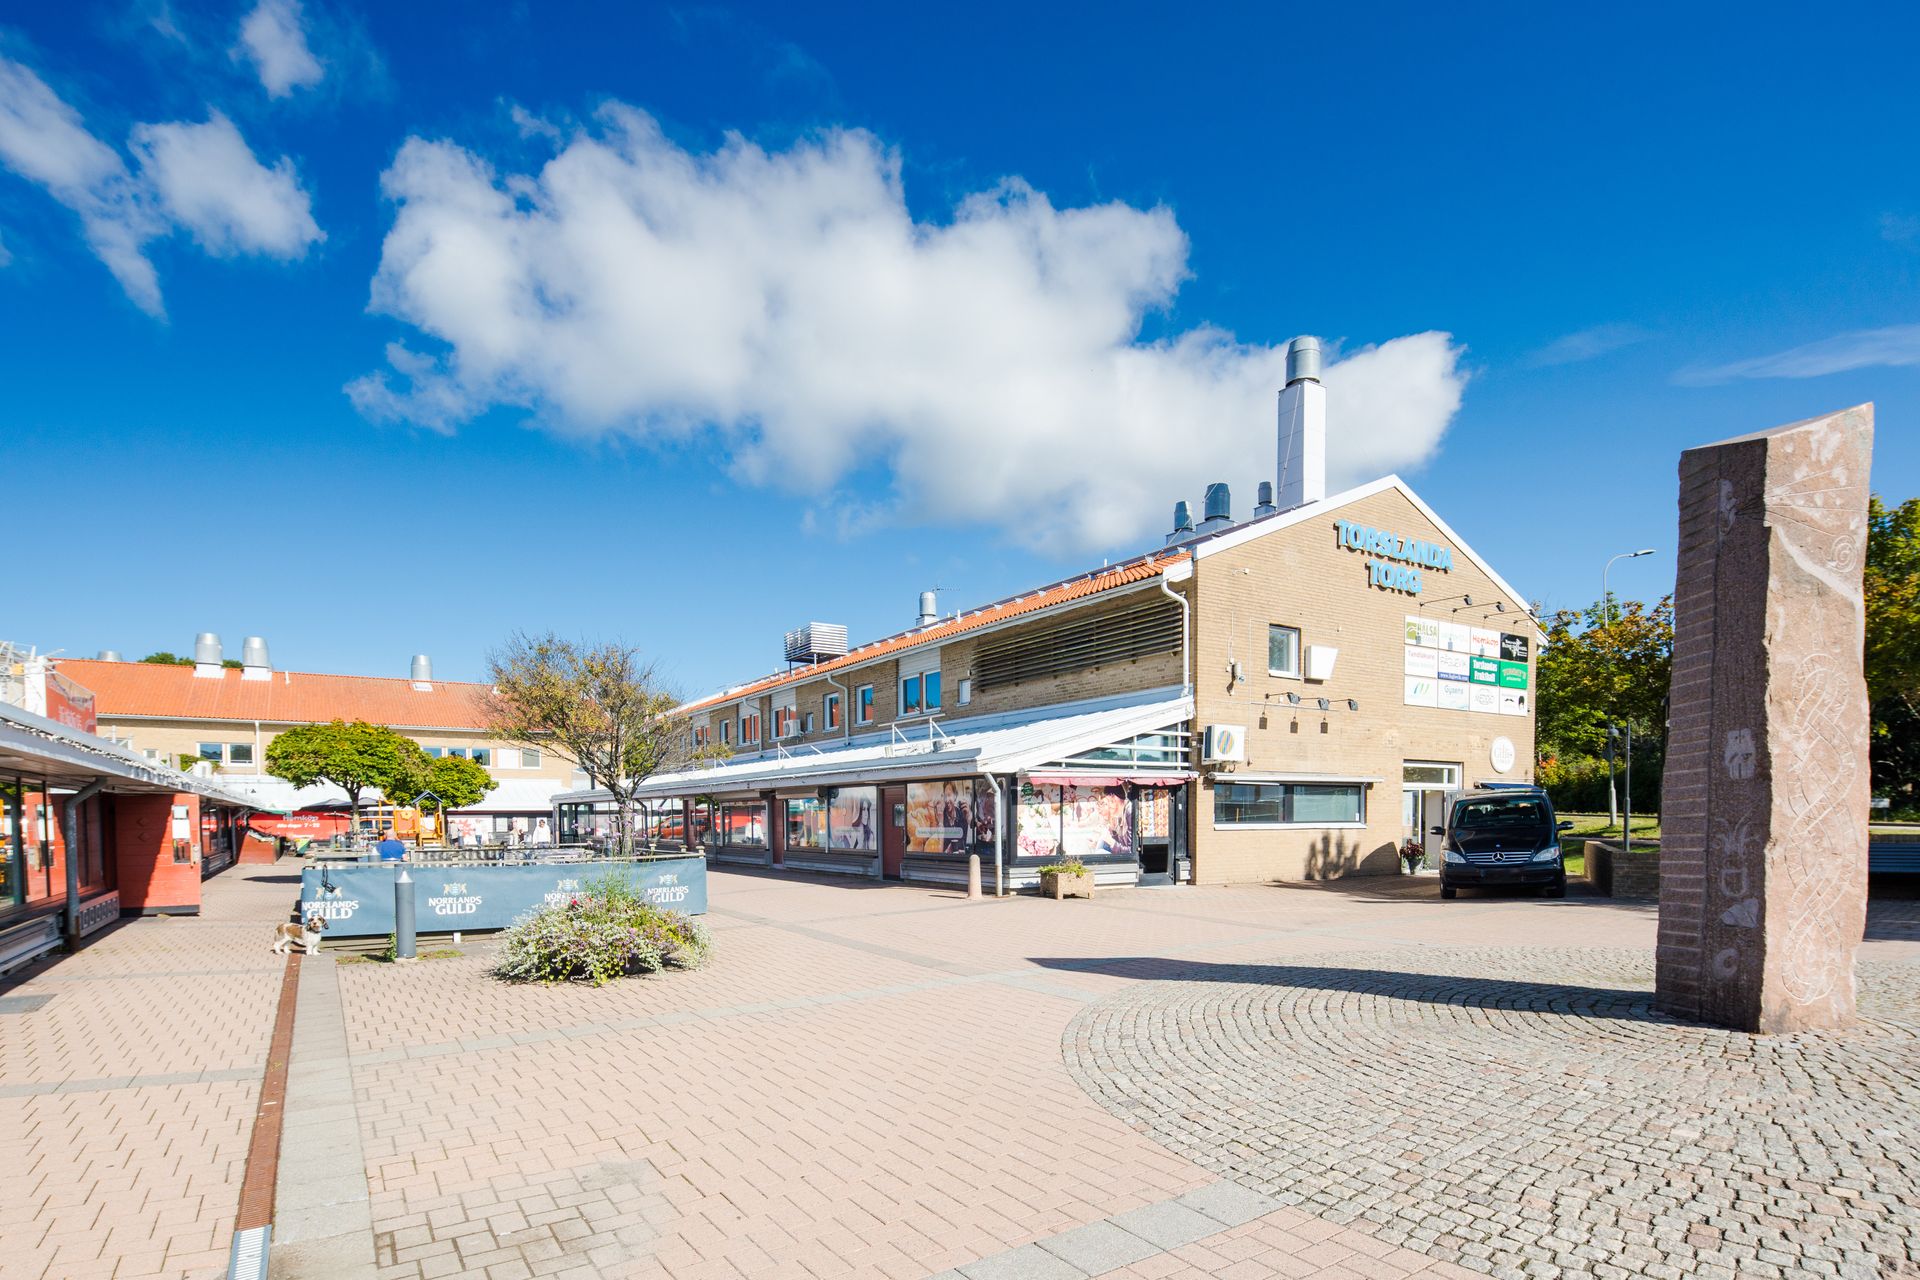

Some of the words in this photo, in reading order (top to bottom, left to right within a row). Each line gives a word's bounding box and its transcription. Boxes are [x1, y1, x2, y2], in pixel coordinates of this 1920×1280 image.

[1336, 519, 1454, 572] TORSLANDA
[1367, 559, 1422, 593] TORG
[428, 896, 482, 907] NORRLANDS
[652, 892, 685, 903] GULD
[302, 900, 359, 910] NORRLANDS
[435, 903, 476, 915] GULD
[306, 908, 352, 920] GULD
